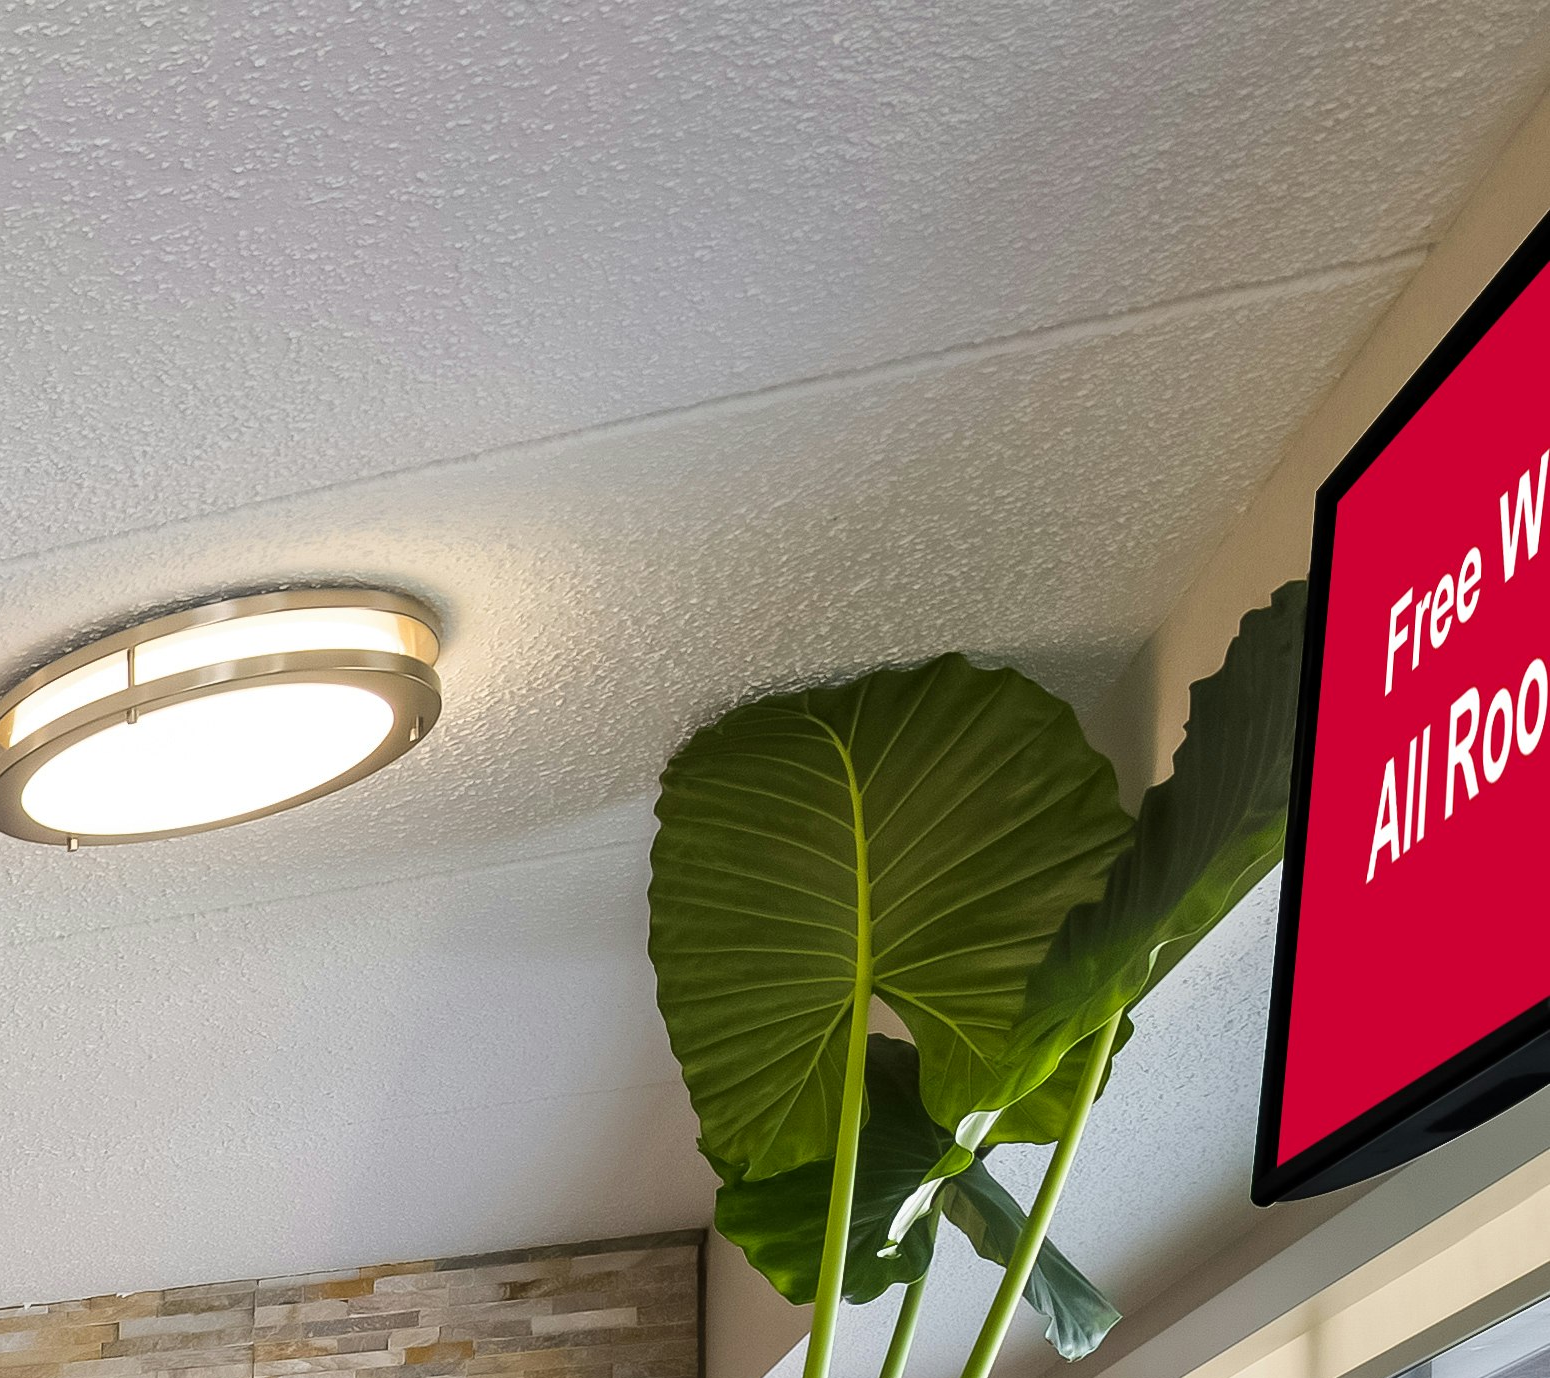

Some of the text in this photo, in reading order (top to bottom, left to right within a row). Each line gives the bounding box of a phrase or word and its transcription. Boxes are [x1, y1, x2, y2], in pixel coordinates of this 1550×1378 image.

[1384, 546, 1482, 697] Free
[1365, 658, 1549, 884] All Roo
